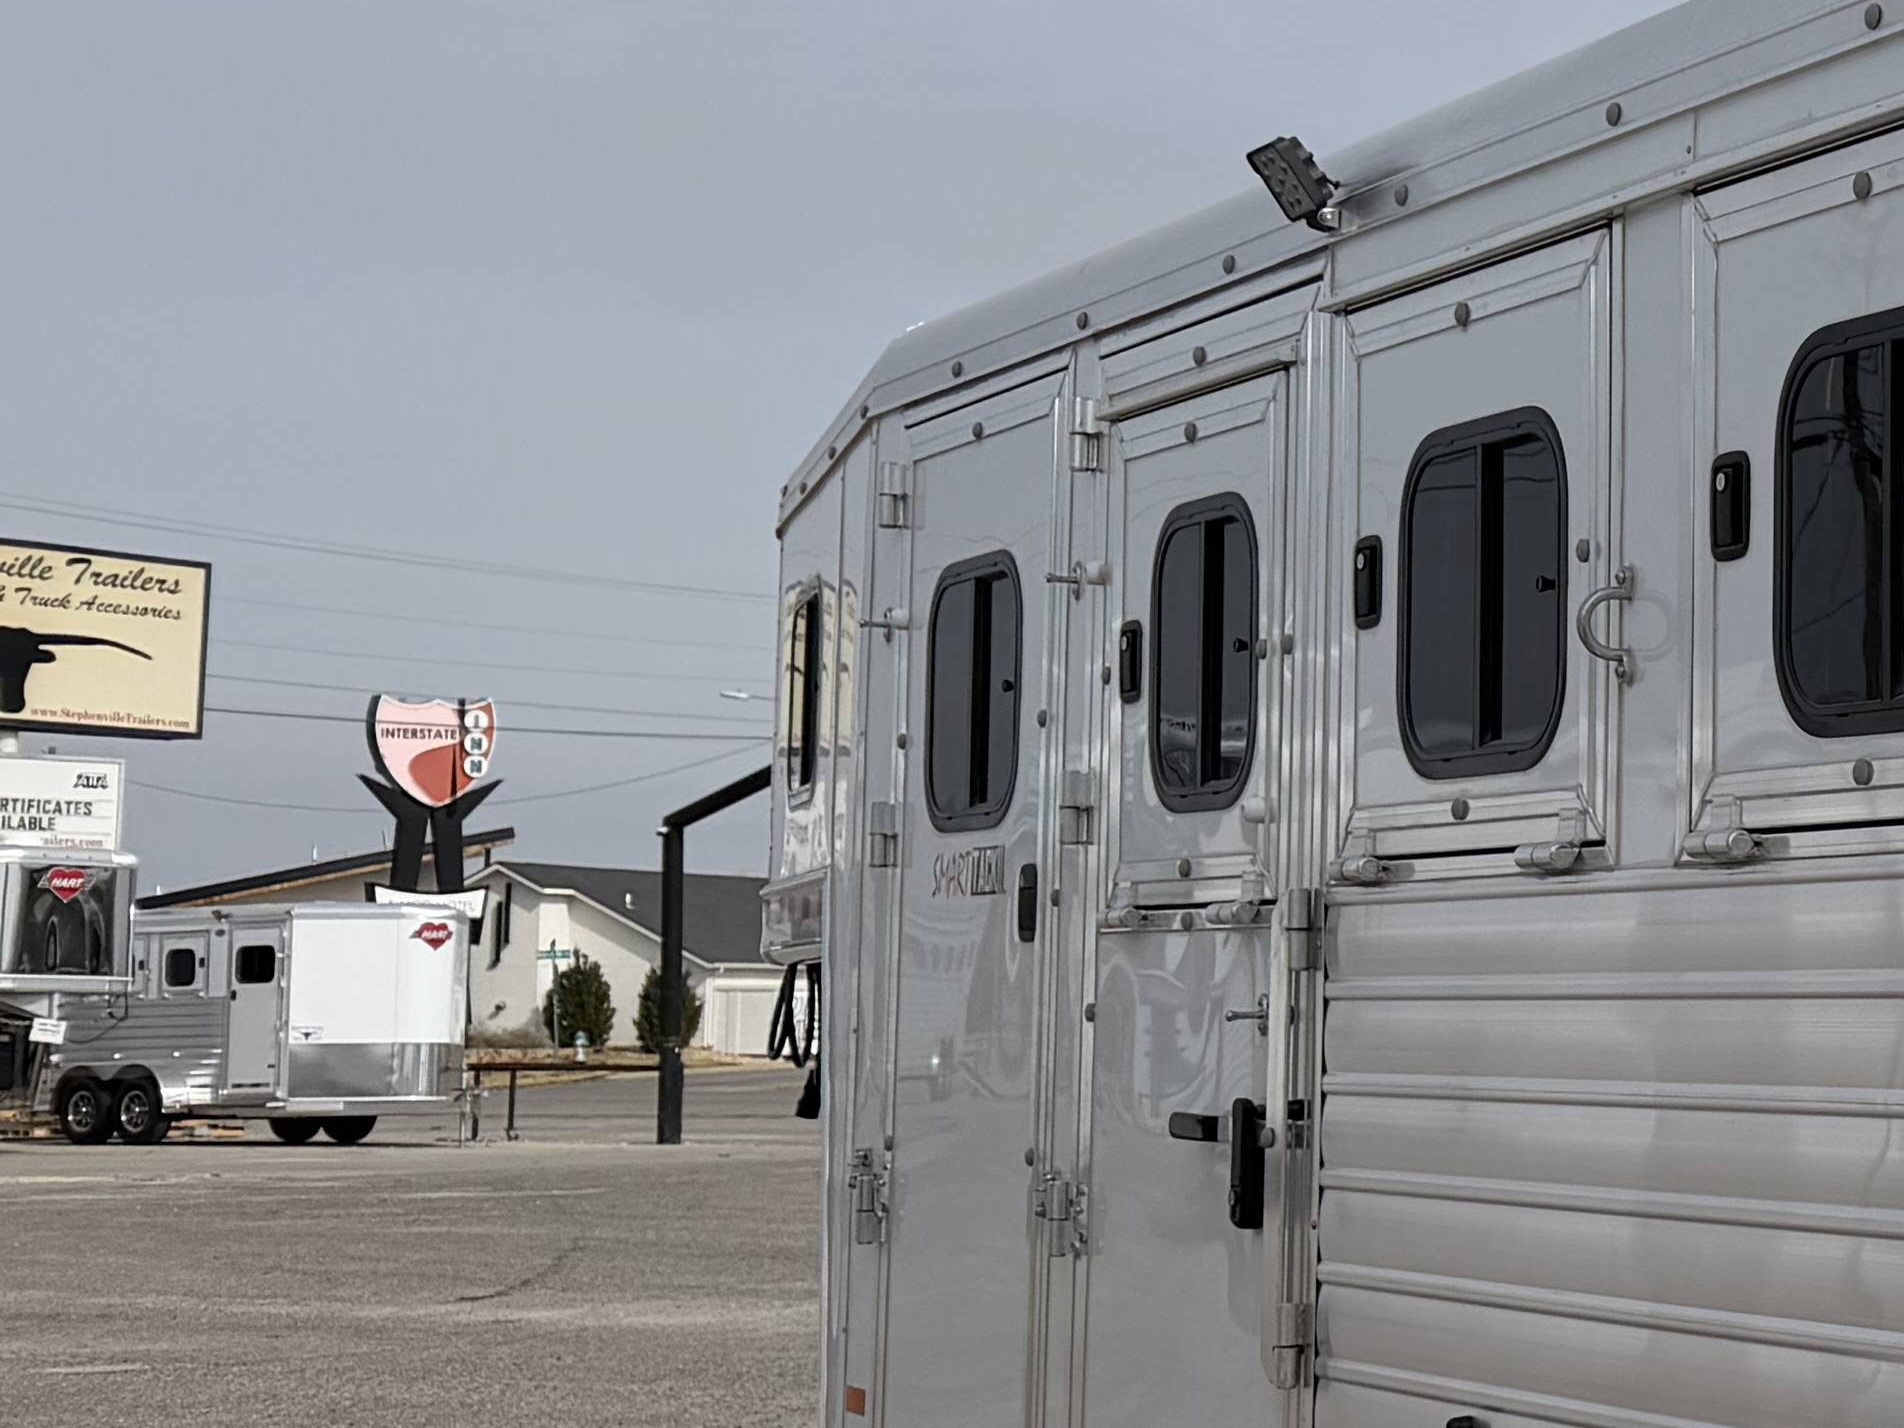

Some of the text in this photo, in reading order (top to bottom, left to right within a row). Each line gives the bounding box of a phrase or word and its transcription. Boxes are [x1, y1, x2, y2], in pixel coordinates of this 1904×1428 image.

[65, 557, 182, 594] Trailers
[14, 587, 72, 609] Truck
[75, 594, 182, 620] Accessories
[380, 727, 458, 740] INTERSTATE
[2, 815, 56, 831] ILABLE
[51, 877, 85, 889] HART
